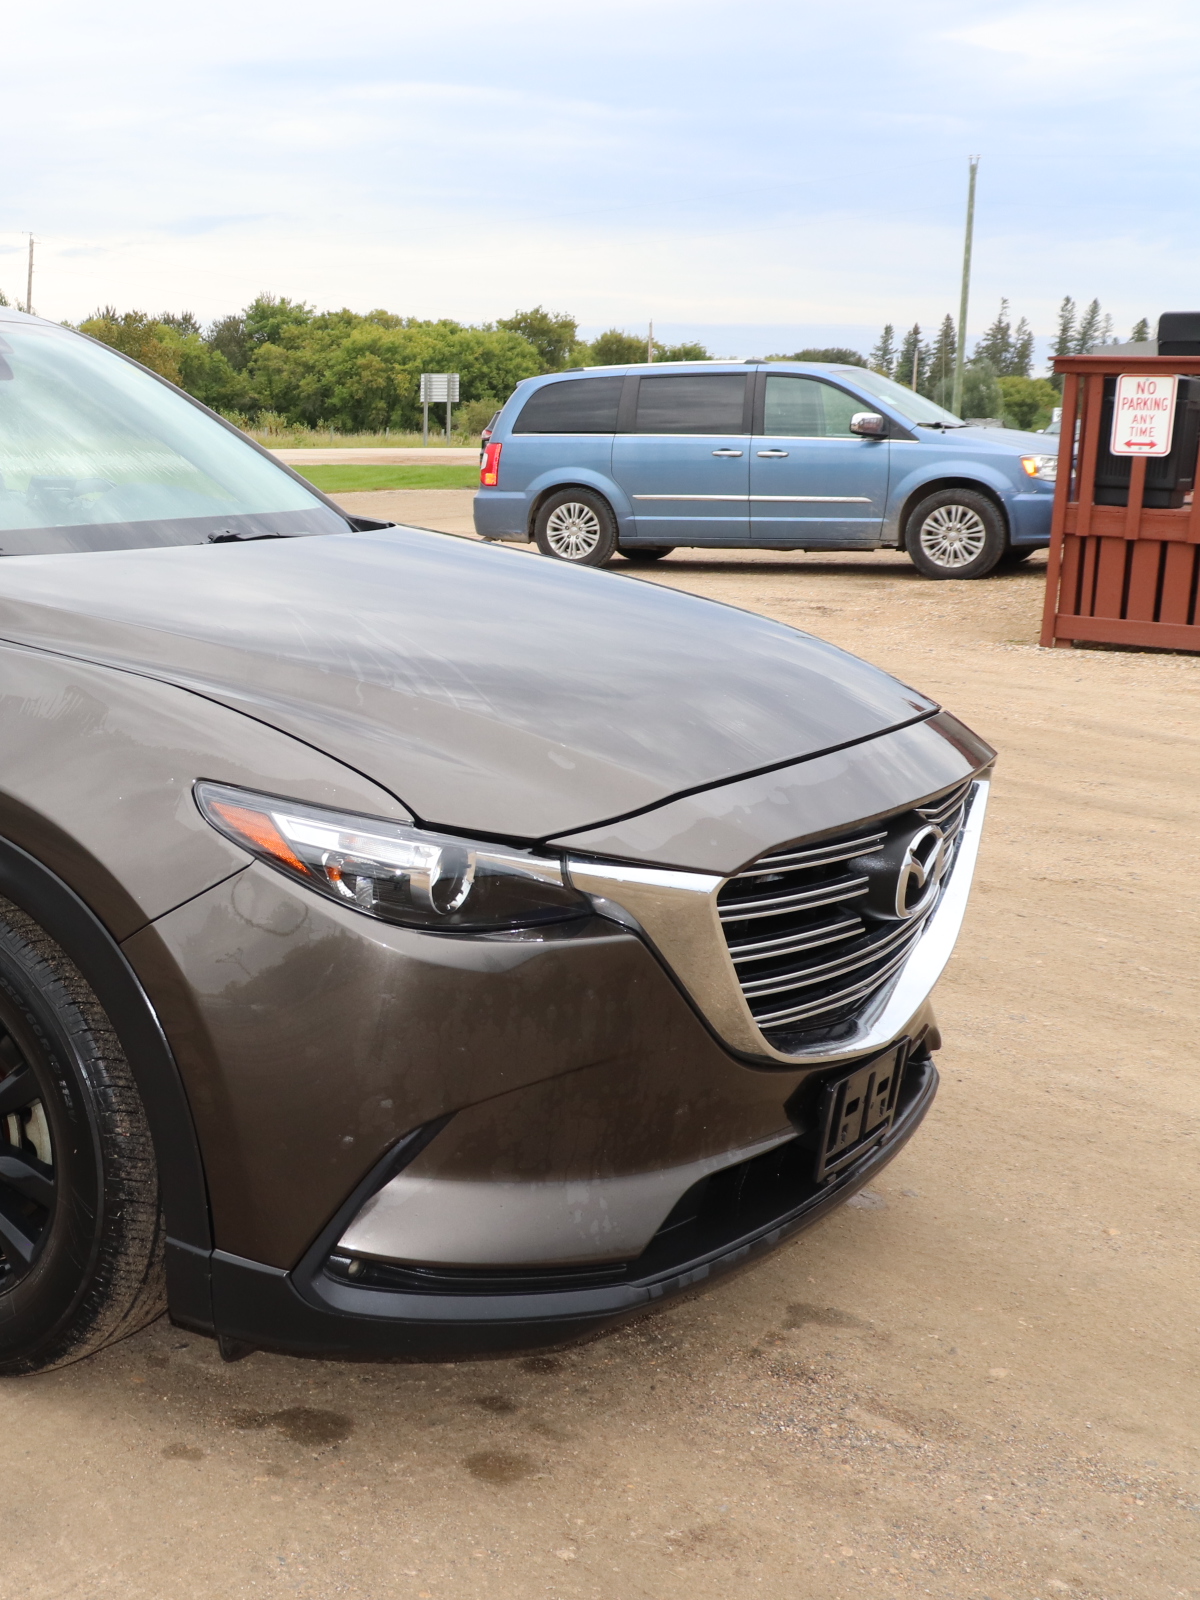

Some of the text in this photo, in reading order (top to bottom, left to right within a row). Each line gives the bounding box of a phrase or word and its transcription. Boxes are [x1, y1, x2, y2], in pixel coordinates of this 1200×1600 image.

[1136, 381, 1157, 394] NO
[1121, 397, 1168, 411] PARKING
[1132, 415, 1155, 424] ANY
[1130, 427, 1155, 437] TIME
